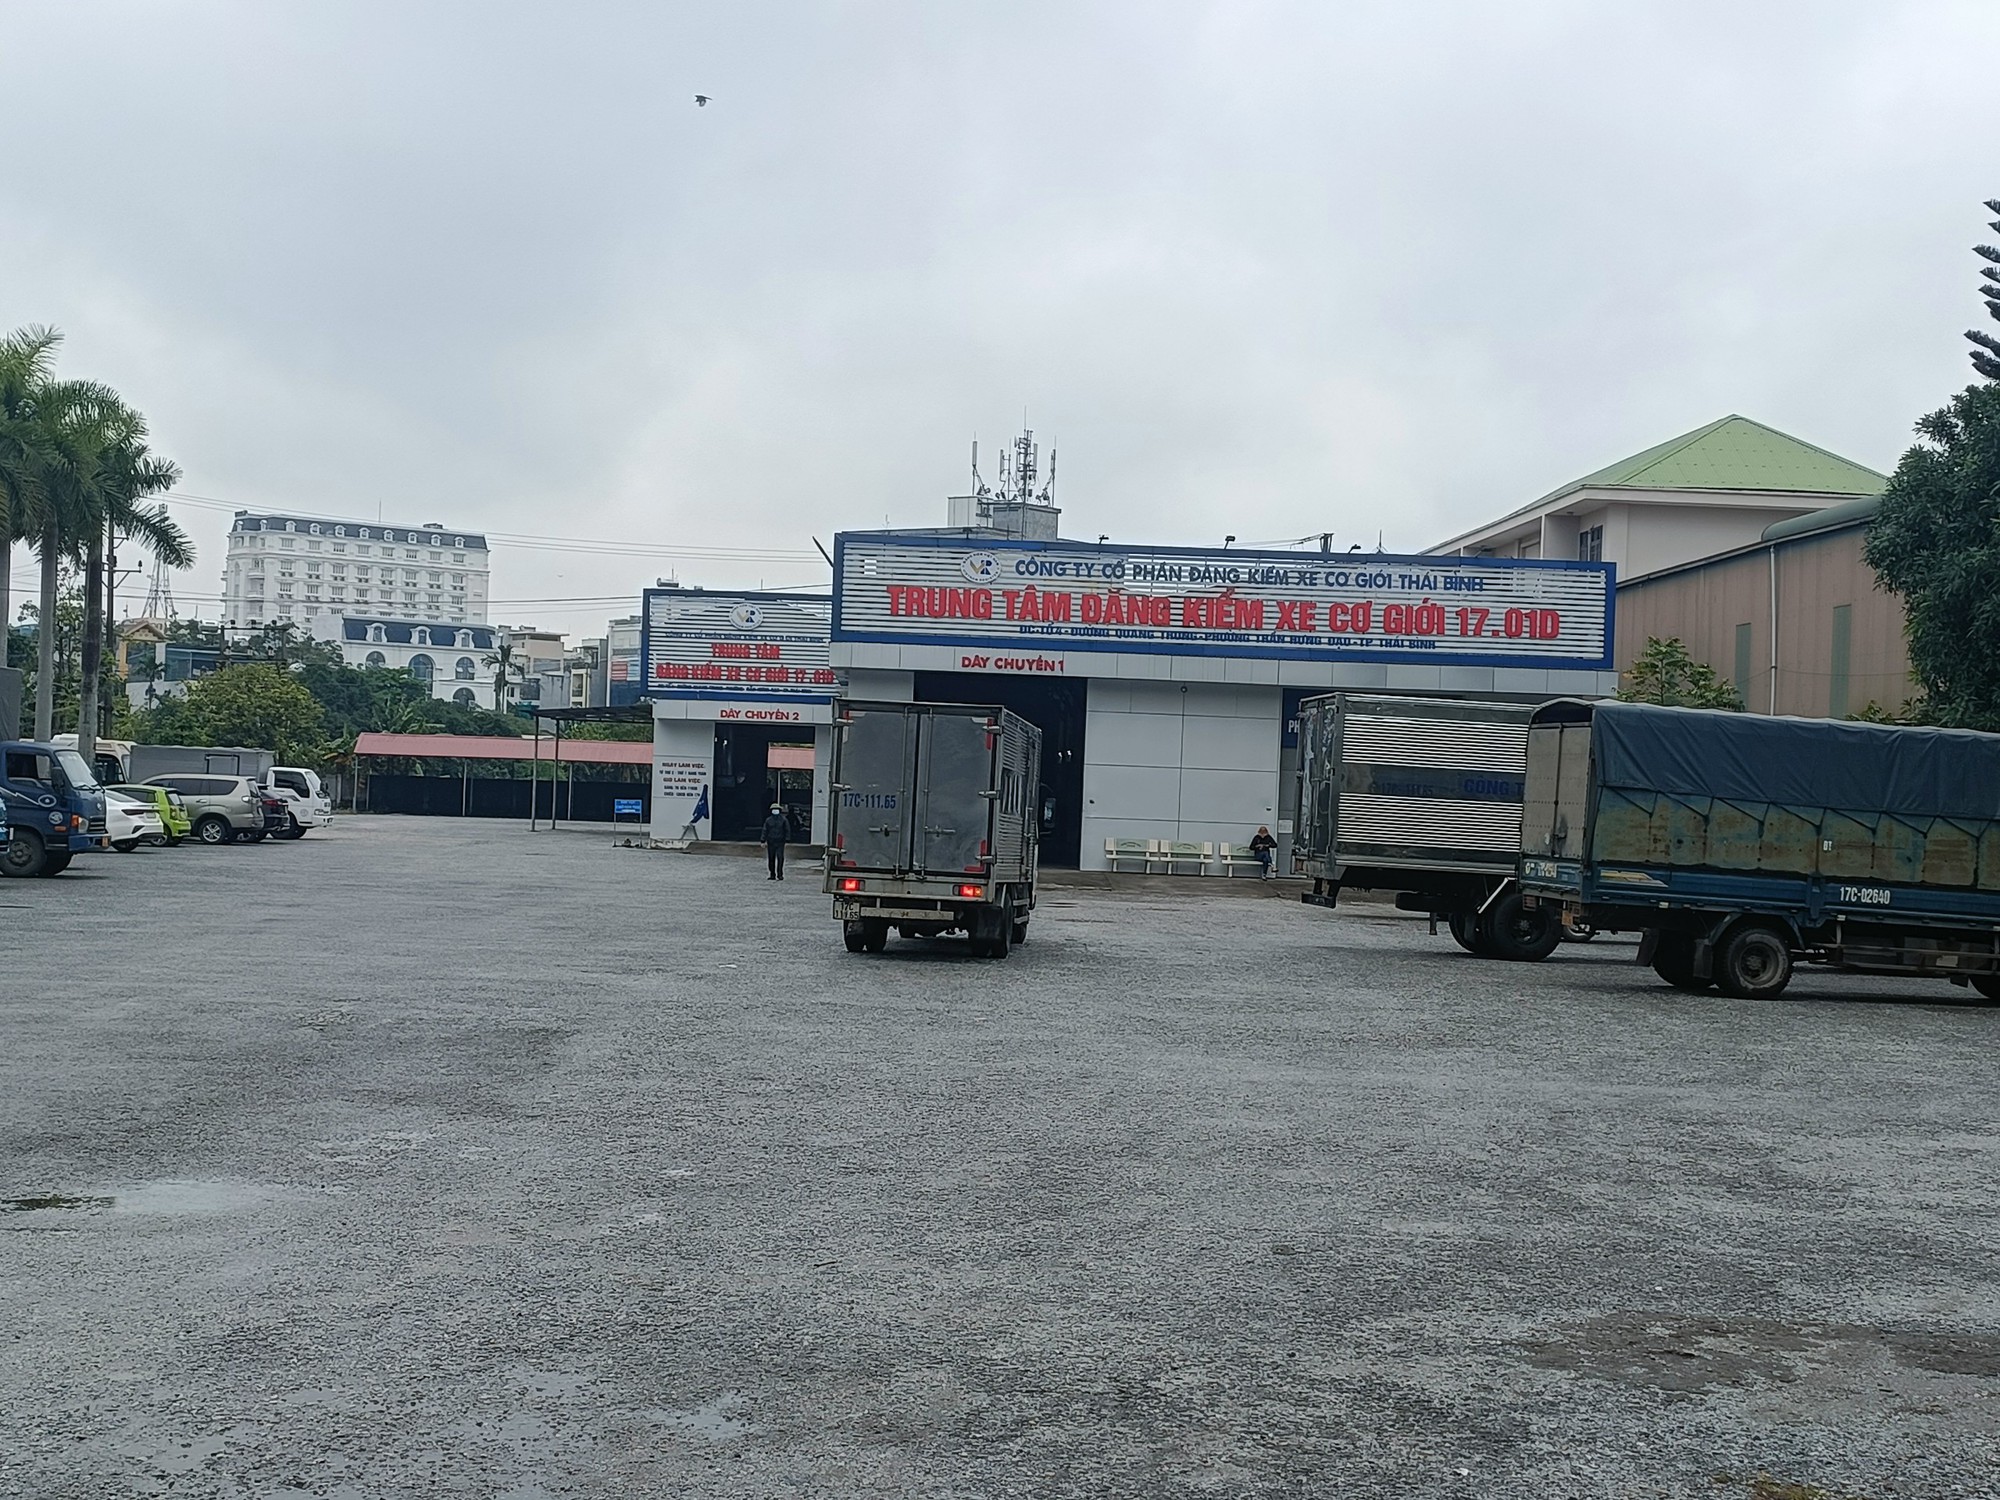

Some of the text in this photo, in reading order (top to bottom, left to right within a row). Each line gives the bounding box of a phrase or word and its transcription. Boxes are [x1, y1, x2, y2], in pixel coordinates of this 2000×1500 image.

[1015, 556, 1067, 577] CÔNG
[1073, 562, 1095, 578] TY
[1102, 559, 1126, 580] CỔ
[1248, 566, 1290, 586] KIỂM
[1295, 571, 1319, 587] XE
[1325, 571, 1351, 588] CƠ
[1355, 569, 1392, 590] GIỚI
[1398, 572, 1438, 591] THÁI
[1443, 570, 1484, 592] BÌNH
[886, 584, 1560, 640] TRUNG TÂM ĐĂNG KIỂM XE CƠ GIỚI 17.01D
[961, 655, 991, 669] DÂY
[1058, 660, 1065, 674] 1
[720, 708, 741, 719] DÂY
[792, 711, 800, 721] 2
[843, 792, 896, 810] 17C-111.65
[1840, 886, 1891, 905] 17C-02640
